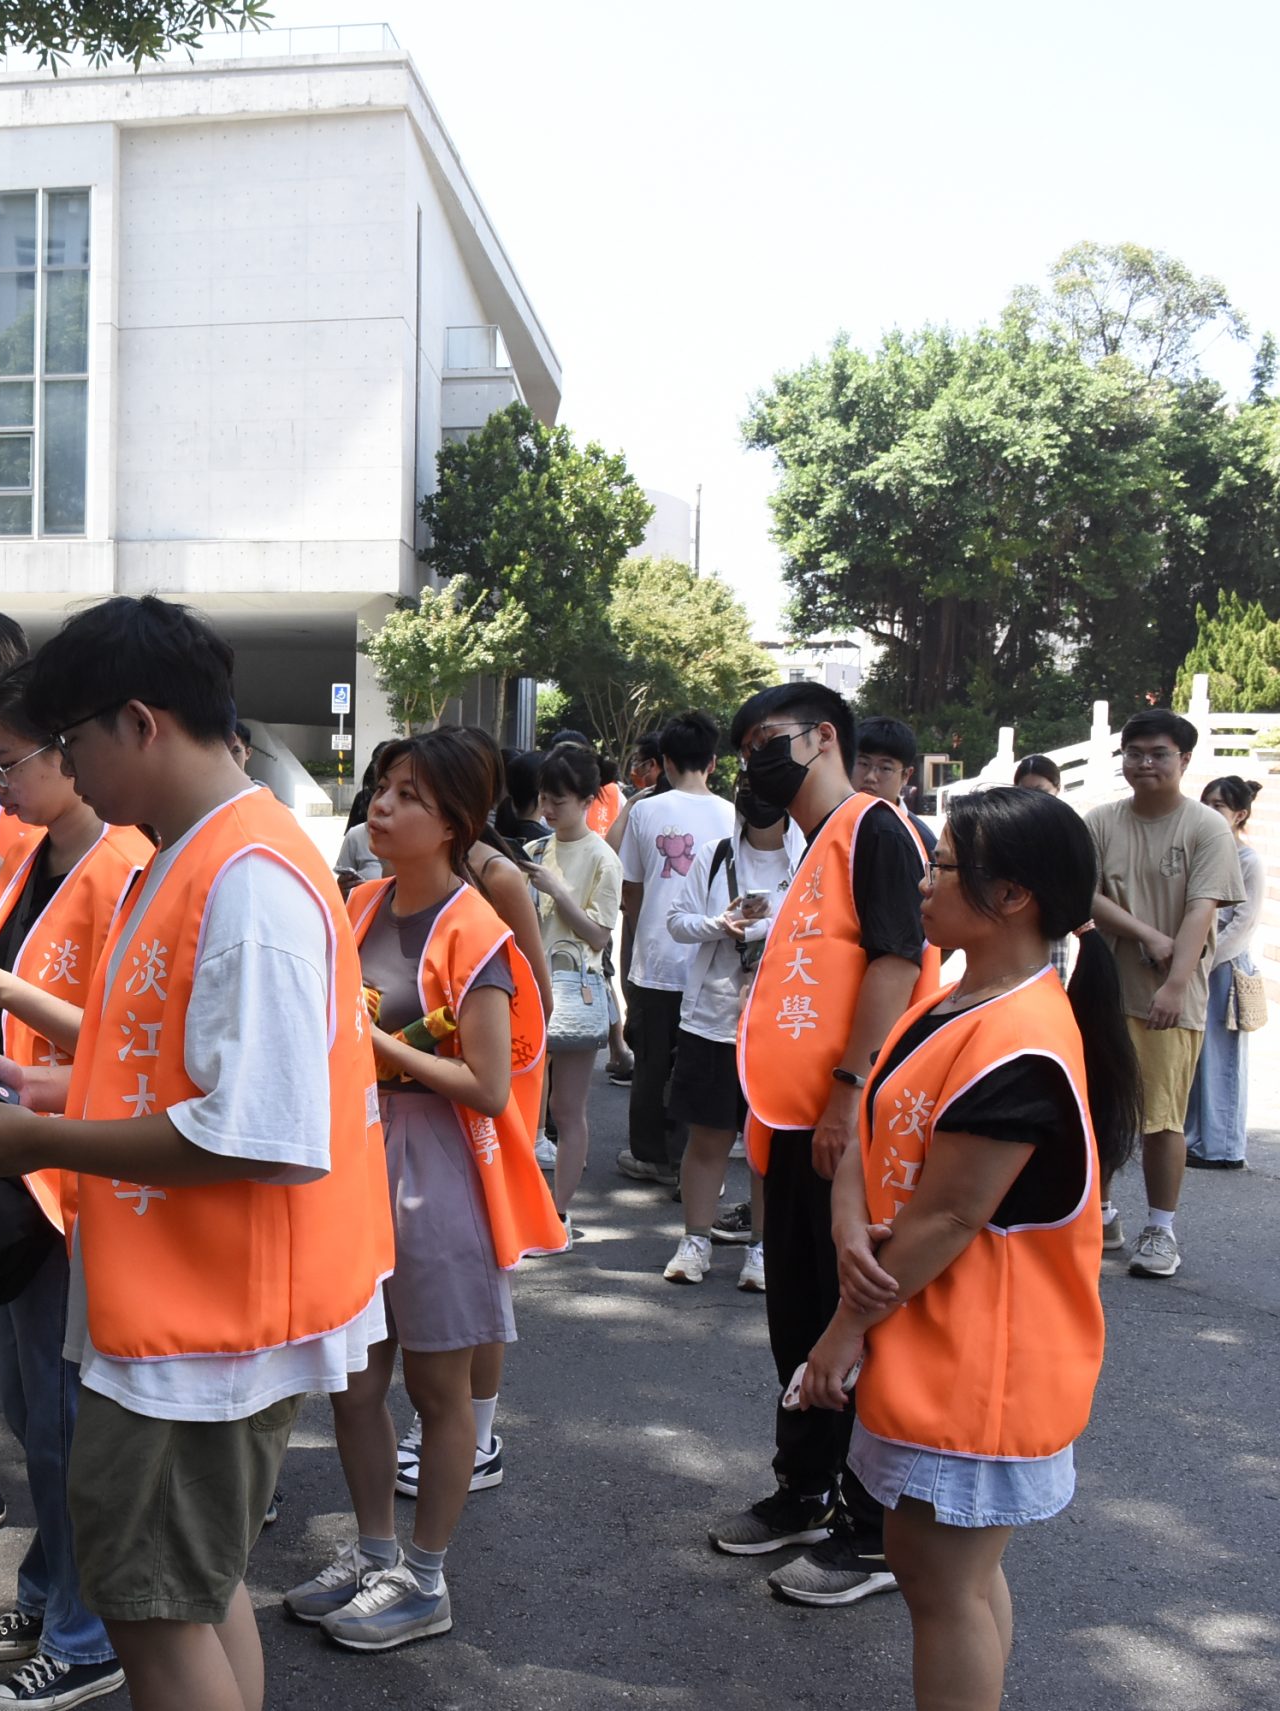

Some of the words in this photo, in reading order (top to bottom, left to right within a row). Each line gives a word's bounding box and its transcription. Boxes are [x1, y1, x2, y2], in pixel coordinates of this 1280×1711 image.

[775, 865, 824, 1040] 淡江大學
[881, 1088, 935, 1225] 淡江
